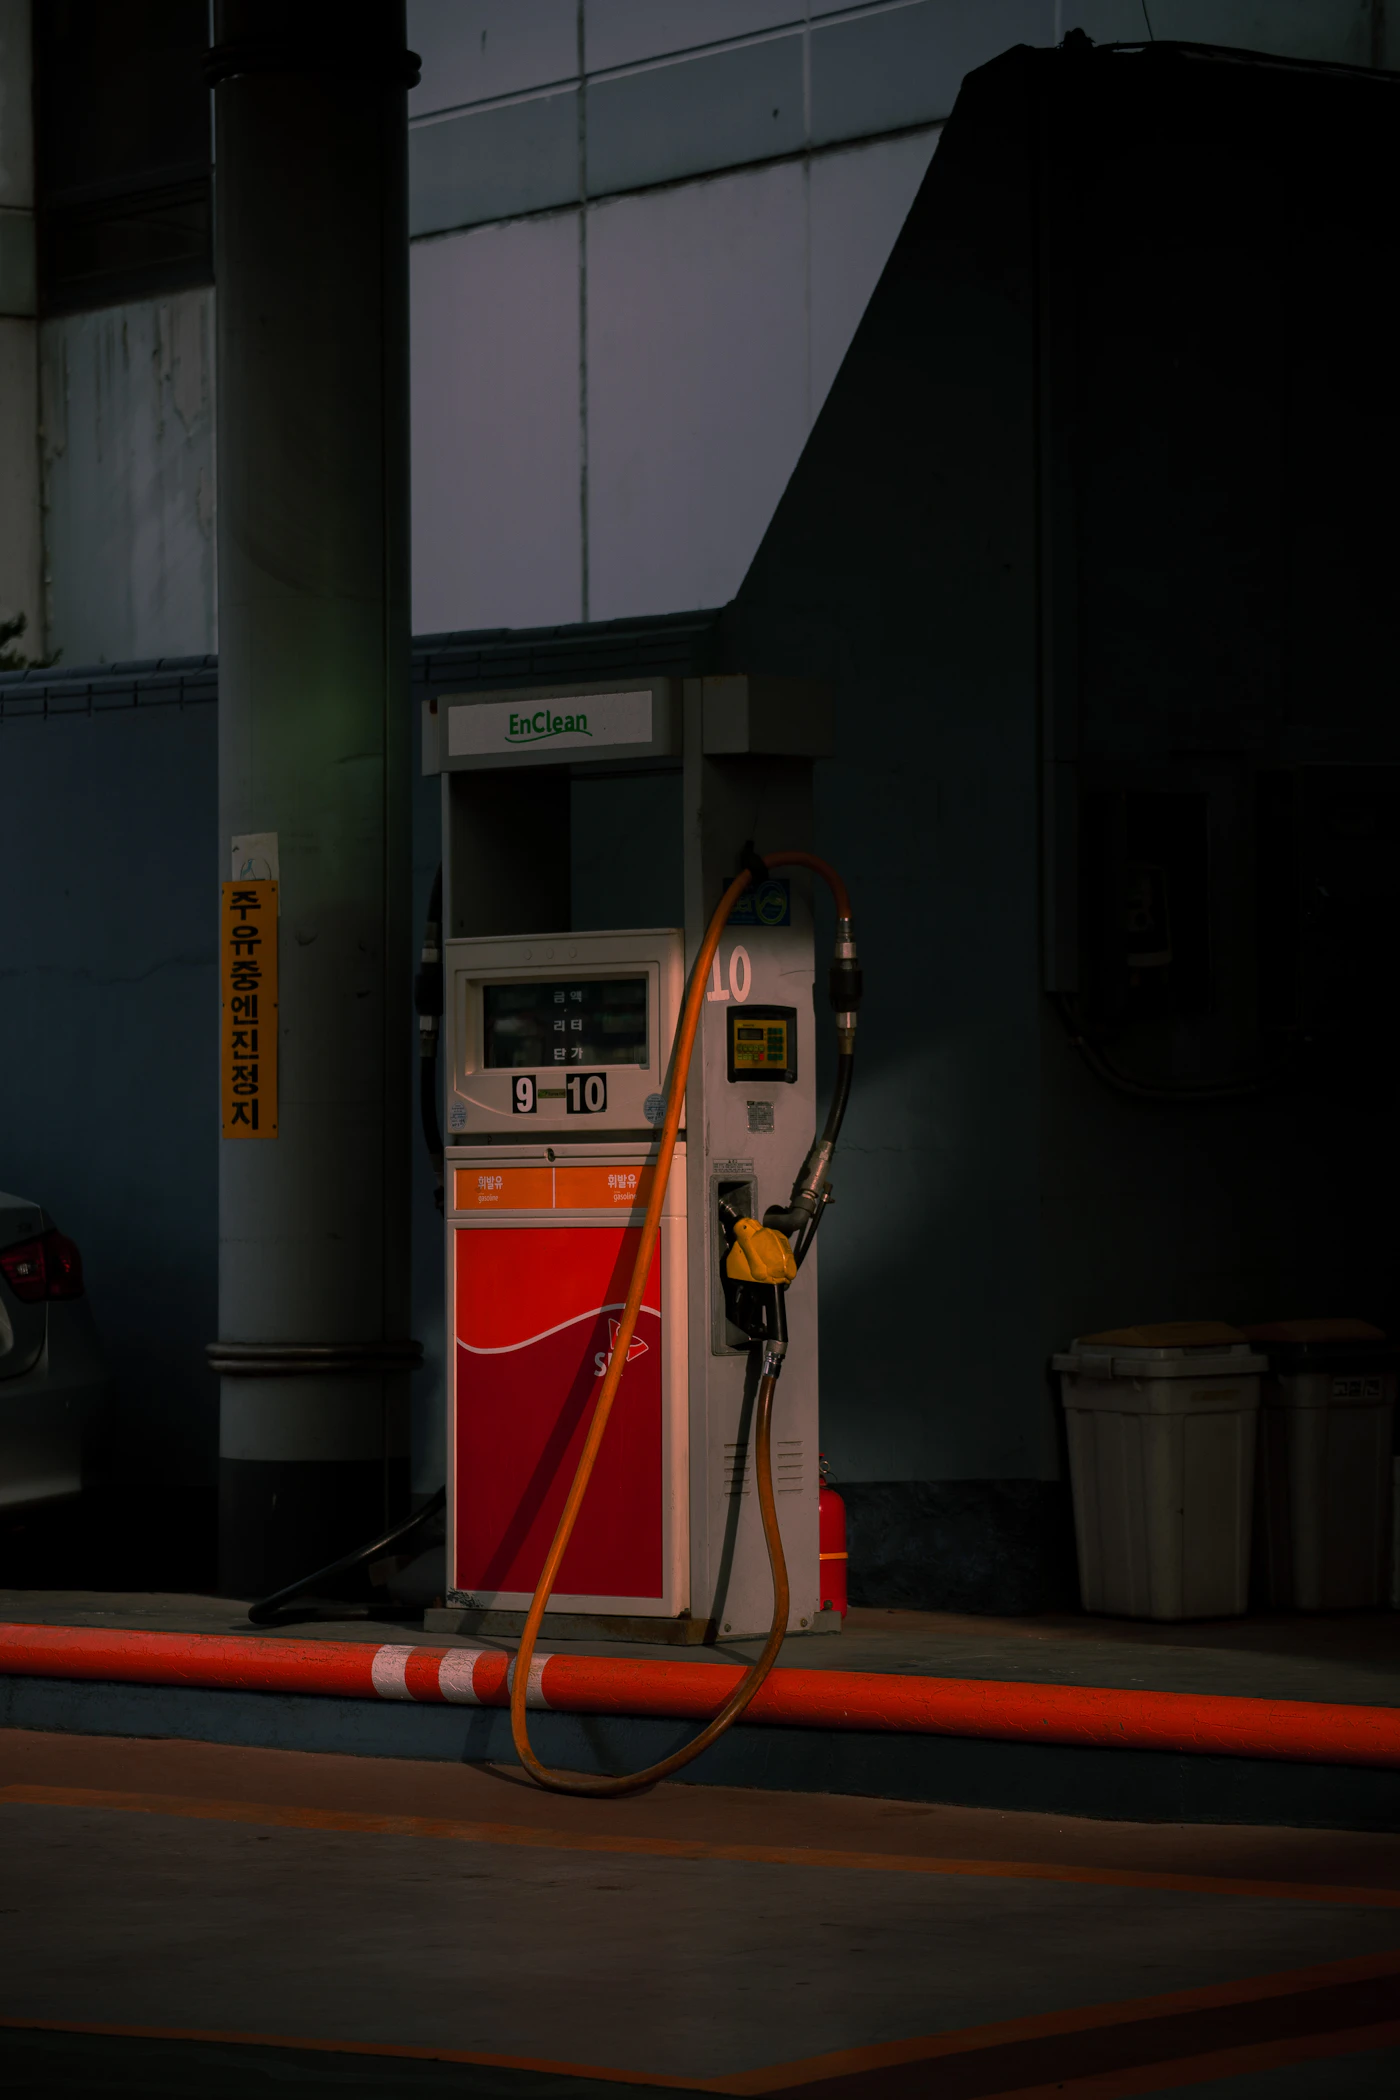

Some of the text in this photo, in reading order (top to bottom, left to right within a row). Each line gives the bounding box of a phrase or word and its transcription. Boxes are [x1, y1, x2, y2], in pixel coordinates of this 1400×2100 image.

[509, 709, 588, 735] EnClean
[706, 945, 752, 1003] 10
[230, 890, 262, 1131] 주유중엔진정지
[515, 1076, 534, 1113] 9
[566, 1075, 606, 1112] 10
[477, 1175, 504, 1190] 휘발유
[607, 1173, 637, 1189] 휘발유
[477, 1193, 499, 1204] gasoline
[613, 1191, 638, 1203] gasoline
